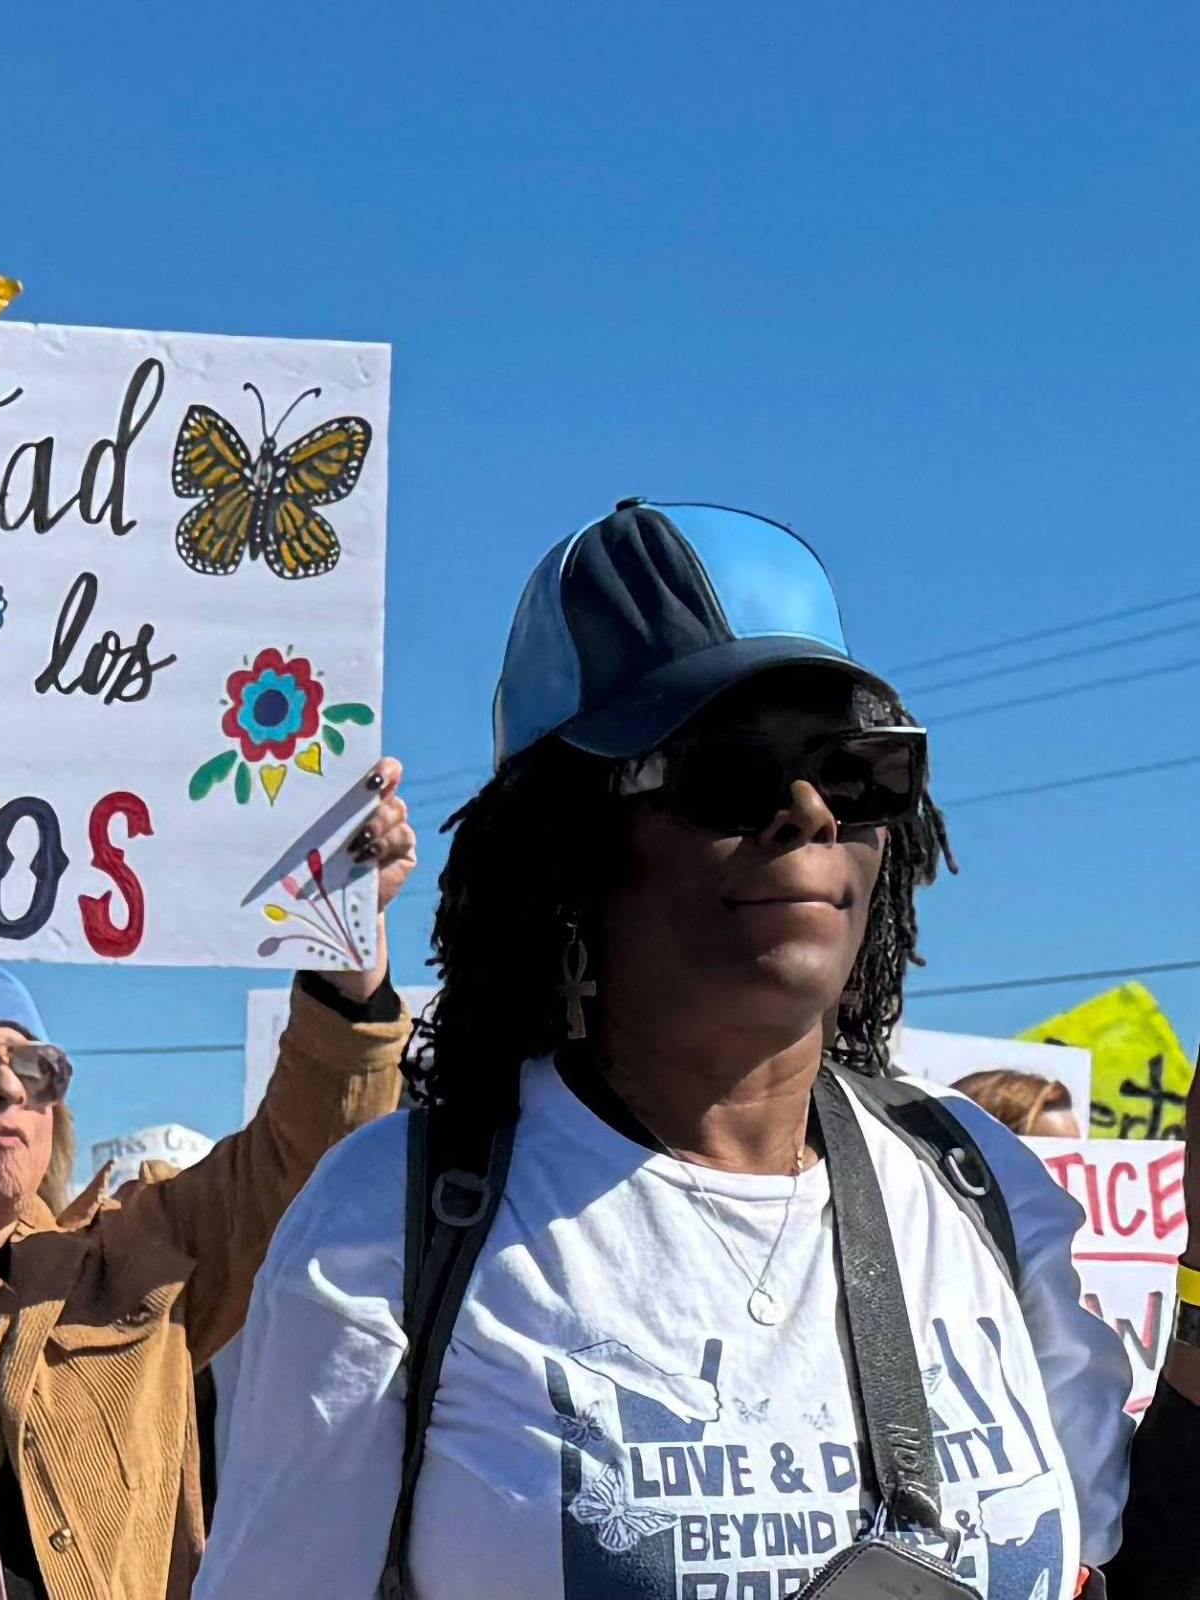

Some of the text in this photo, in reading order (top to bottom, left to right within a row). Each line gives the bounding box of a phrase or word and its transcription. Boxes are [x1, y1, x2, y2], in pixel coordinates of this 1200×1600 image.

[35, 571, 177, 705] los
[1044, 1152, 1186, 1239] TICE
[630, 1445, 755, 1499] LOVE
[769, 1441, 812, 1494] &
[819, 1425, 1013, 1494] DITY
[680, 1510, 837, 1562] BEYOND
